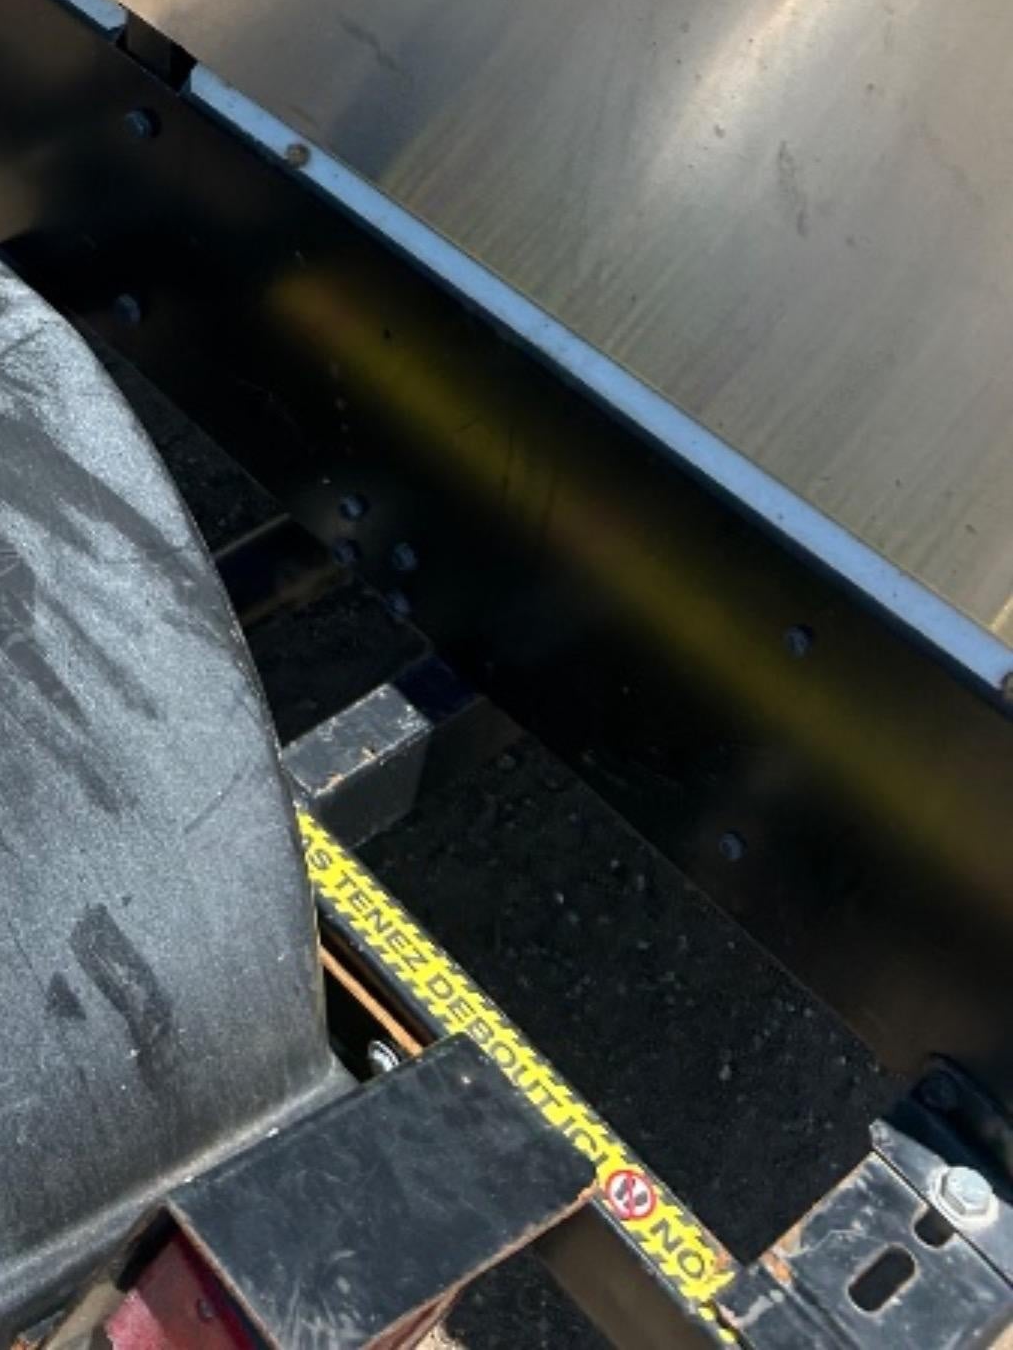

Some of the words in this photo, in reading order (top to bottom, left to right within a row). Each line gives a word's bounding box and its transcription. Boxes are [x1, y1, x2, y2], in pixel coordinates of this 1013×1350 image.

[335, 869, 430, 973] TENEZ
[426, 973, 564, 1108] DEBOUT
[649, 1217, 706, 1280] NO
